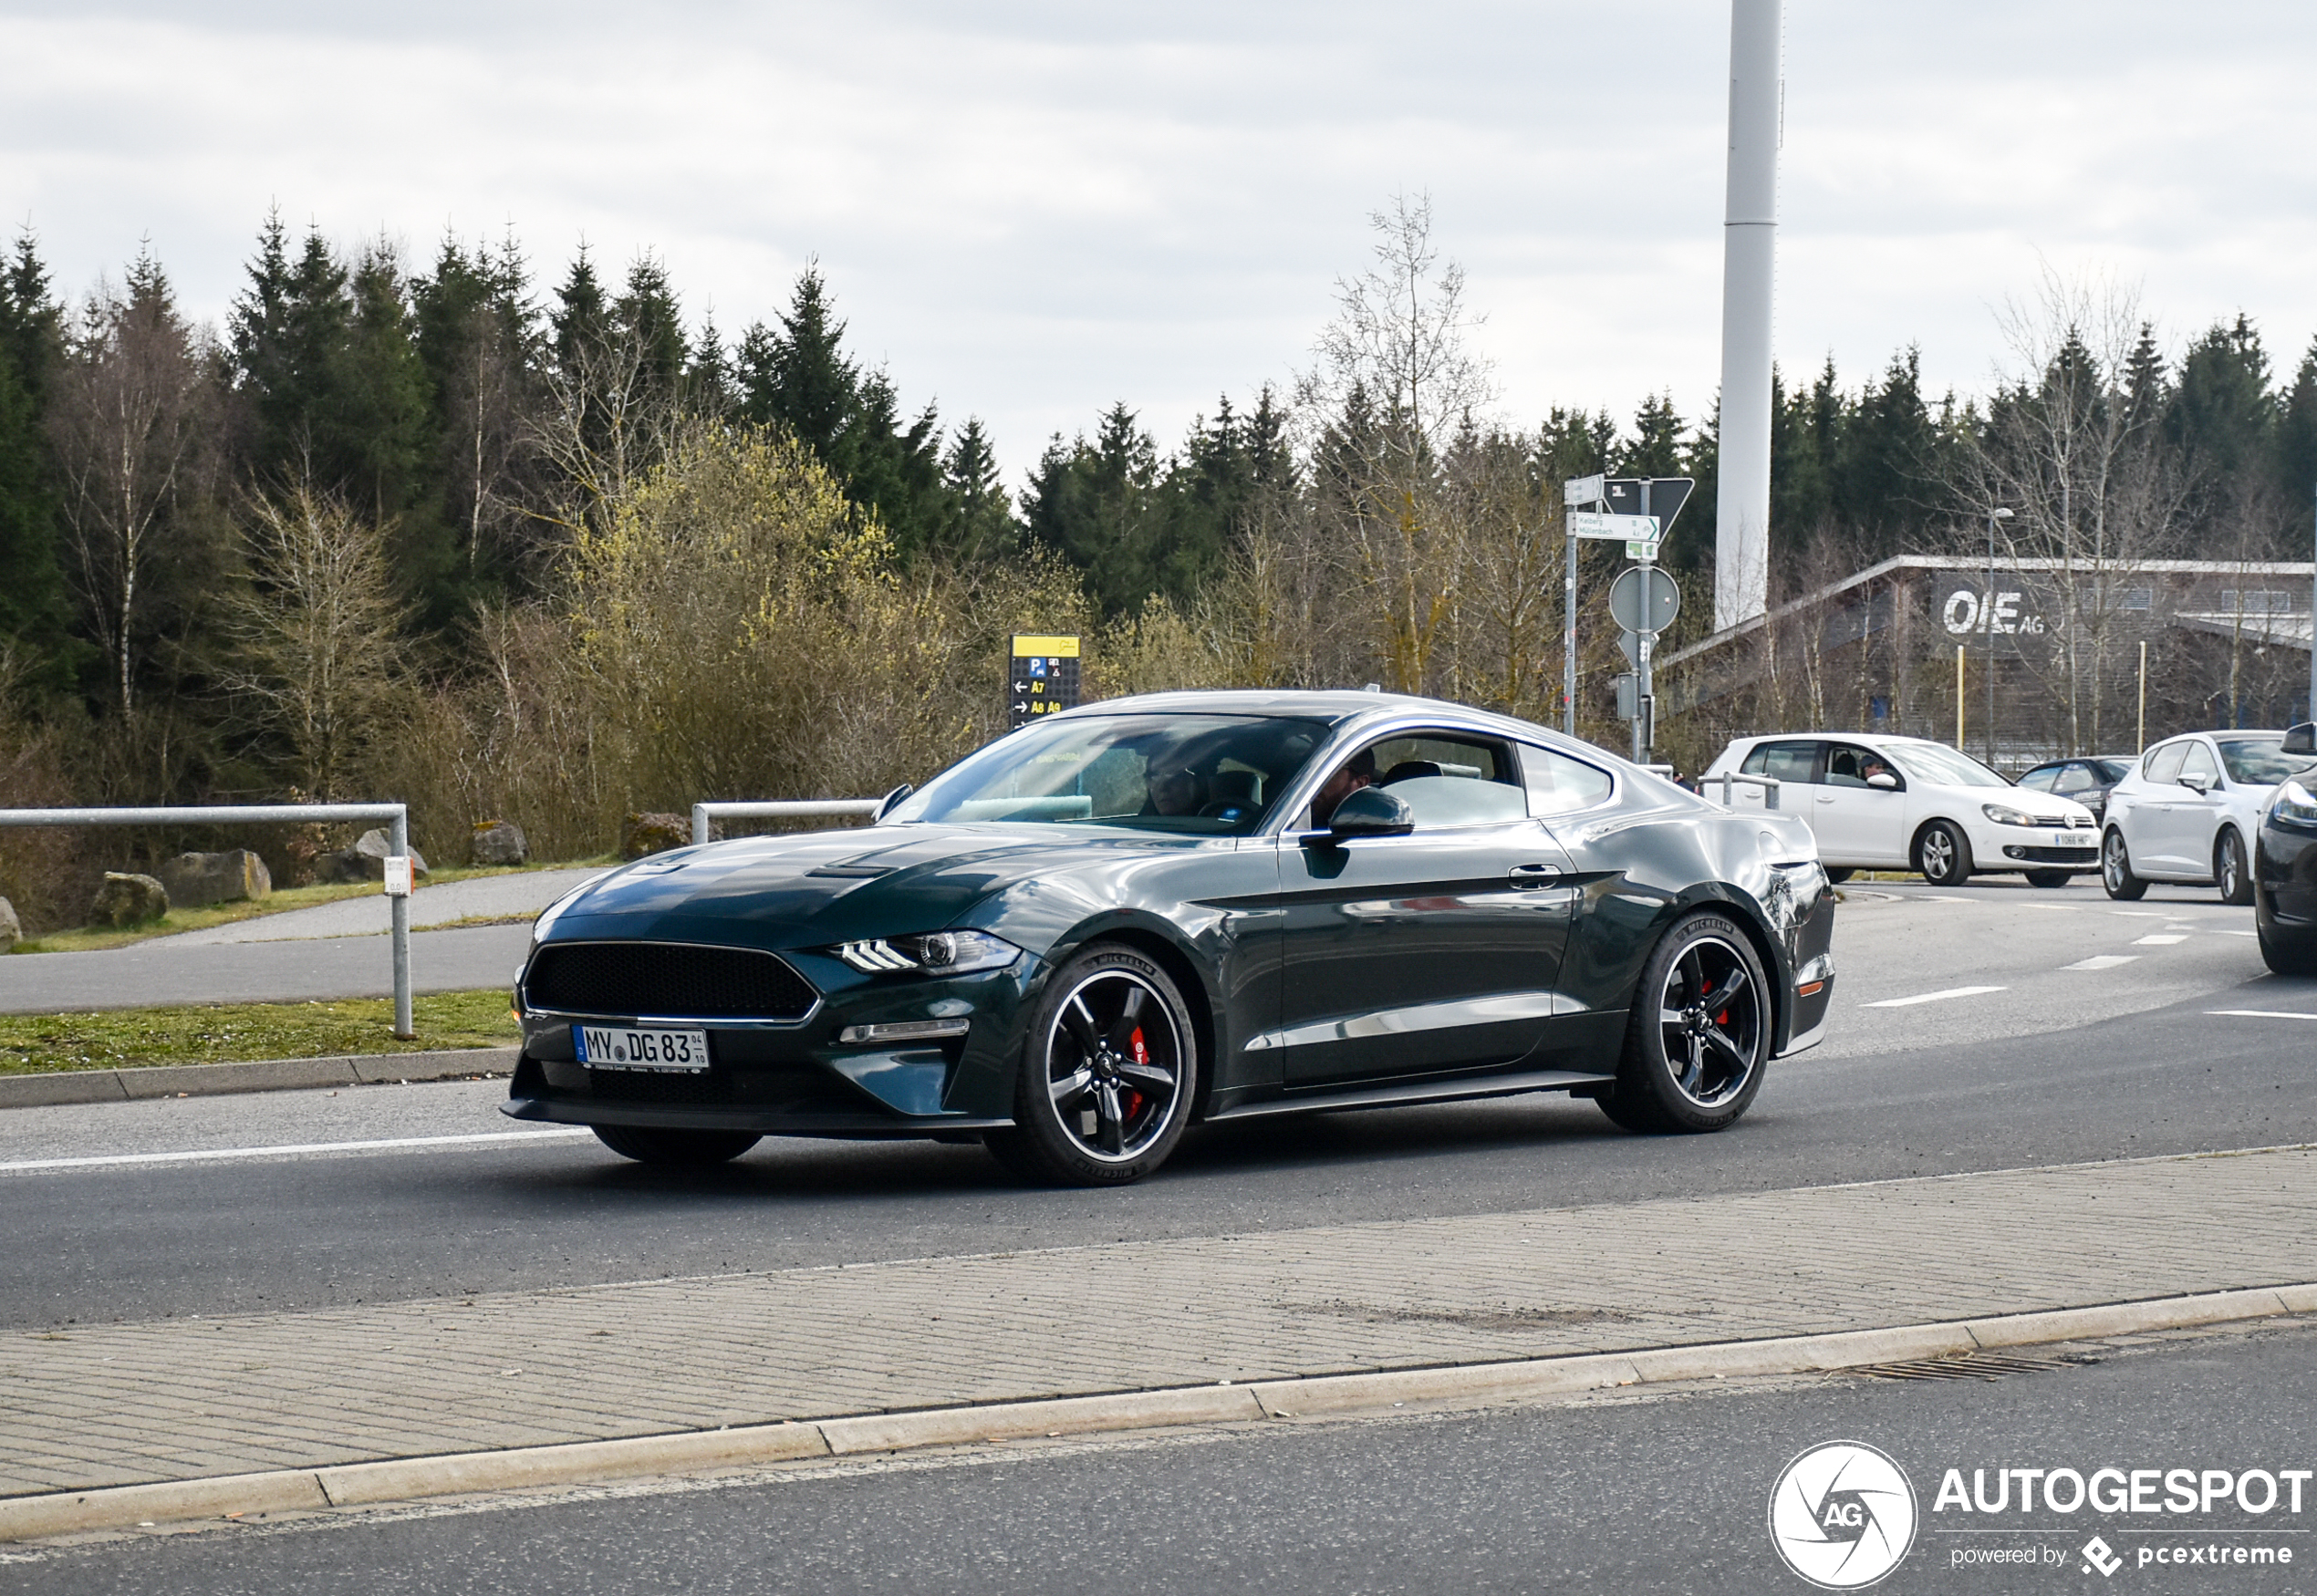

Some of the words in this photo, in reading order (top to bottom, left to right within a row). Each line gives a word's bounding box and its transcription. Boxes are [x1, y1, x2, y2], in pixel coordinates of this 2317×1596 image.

[1943, 590, 2022, 634] OIE
[2018, 616, 2044, 634] AG
[1031, 680, 1045, 693] A7
[1031, 700, 1045, 713] A8
[1046, 700, 1062, 713] A9
[1687, 919, 1733, 934] MICHELIN
[1097, 954, 1156, 975] MICHELIN
[691, 1035, 702, 1043] 04
[585, 1030, 611, 1060] MY
[626, 1032, 659, 1062] DG
[660, 1034, 691, 1063] 83
[695, 1055, 705, 1063] 10
